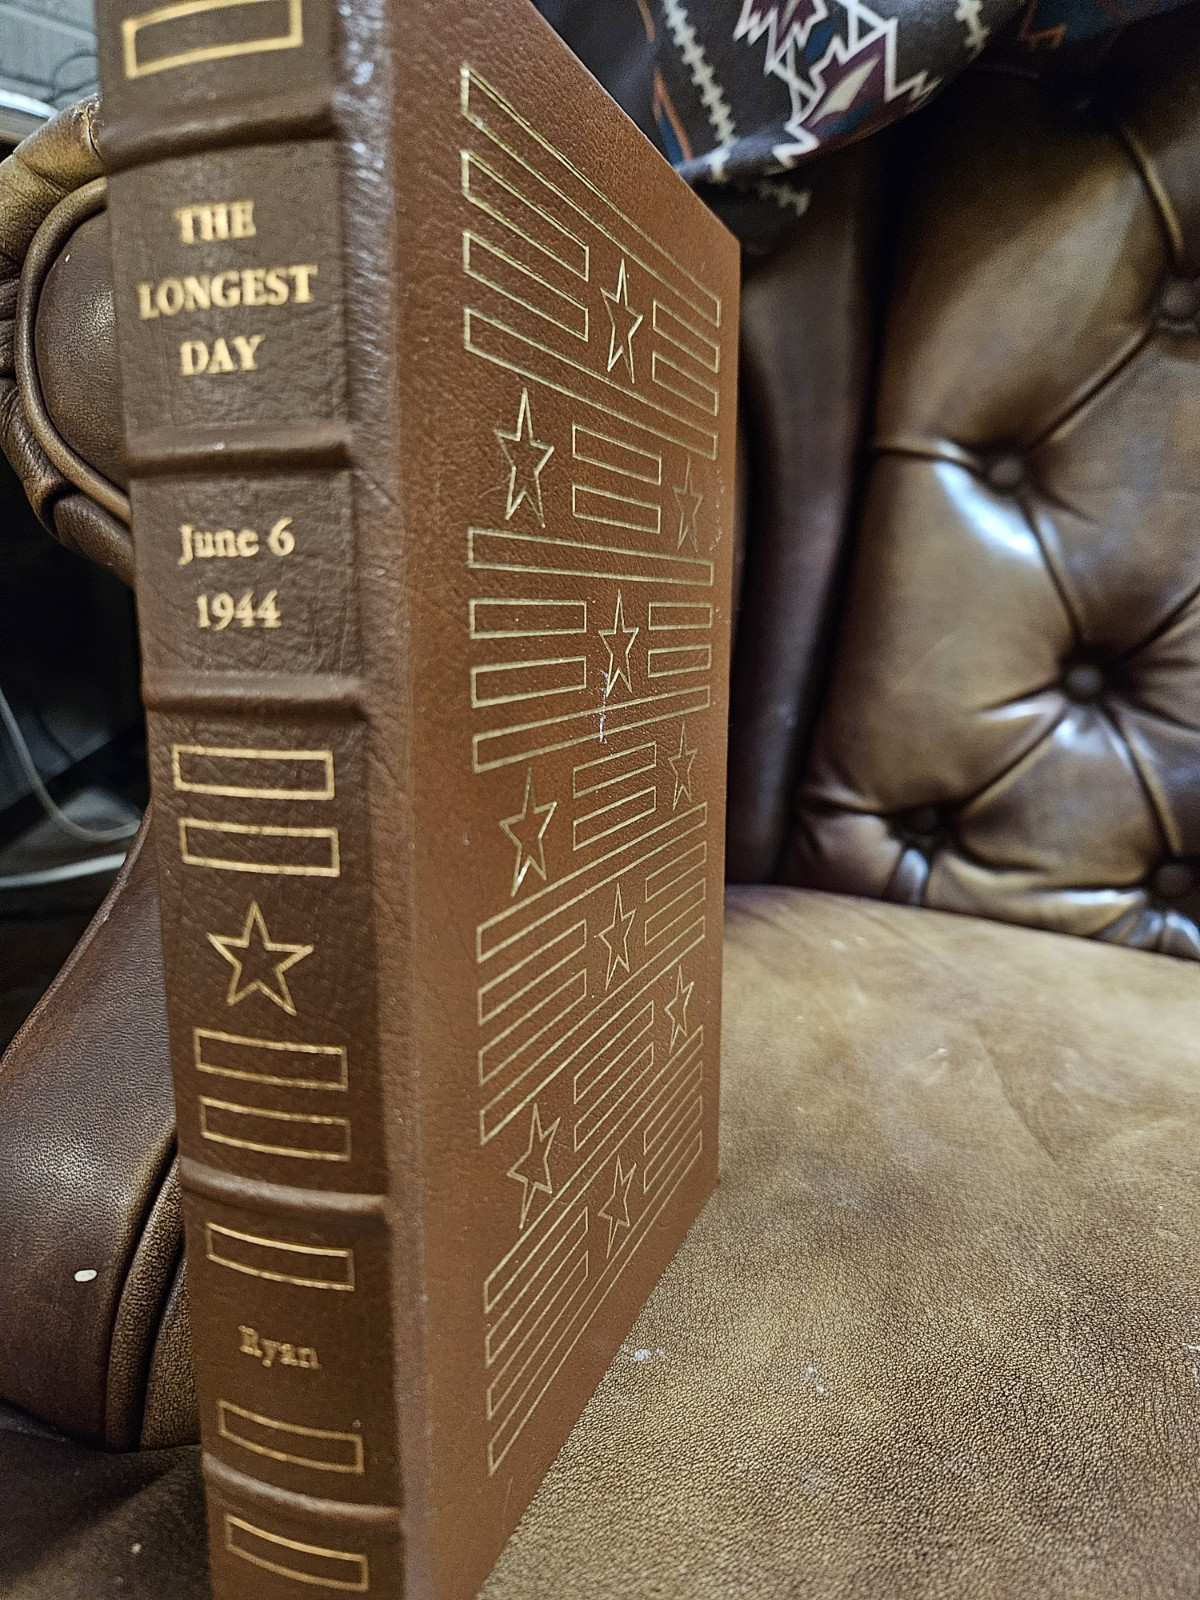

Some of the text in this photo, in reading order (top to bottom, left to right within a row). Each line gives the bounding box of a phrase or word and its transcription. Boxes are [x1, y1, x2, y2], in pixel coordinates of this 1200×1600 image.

[173, 200, 256, 244] THE
[137, 263, 319, 320] LONGEST
[179, 333, 265, 376] DAY
[177, 516, 295, 566] June 6
[197, 588, 282, 631] 1944
[237, 1325, 321, 1370] Ryan
